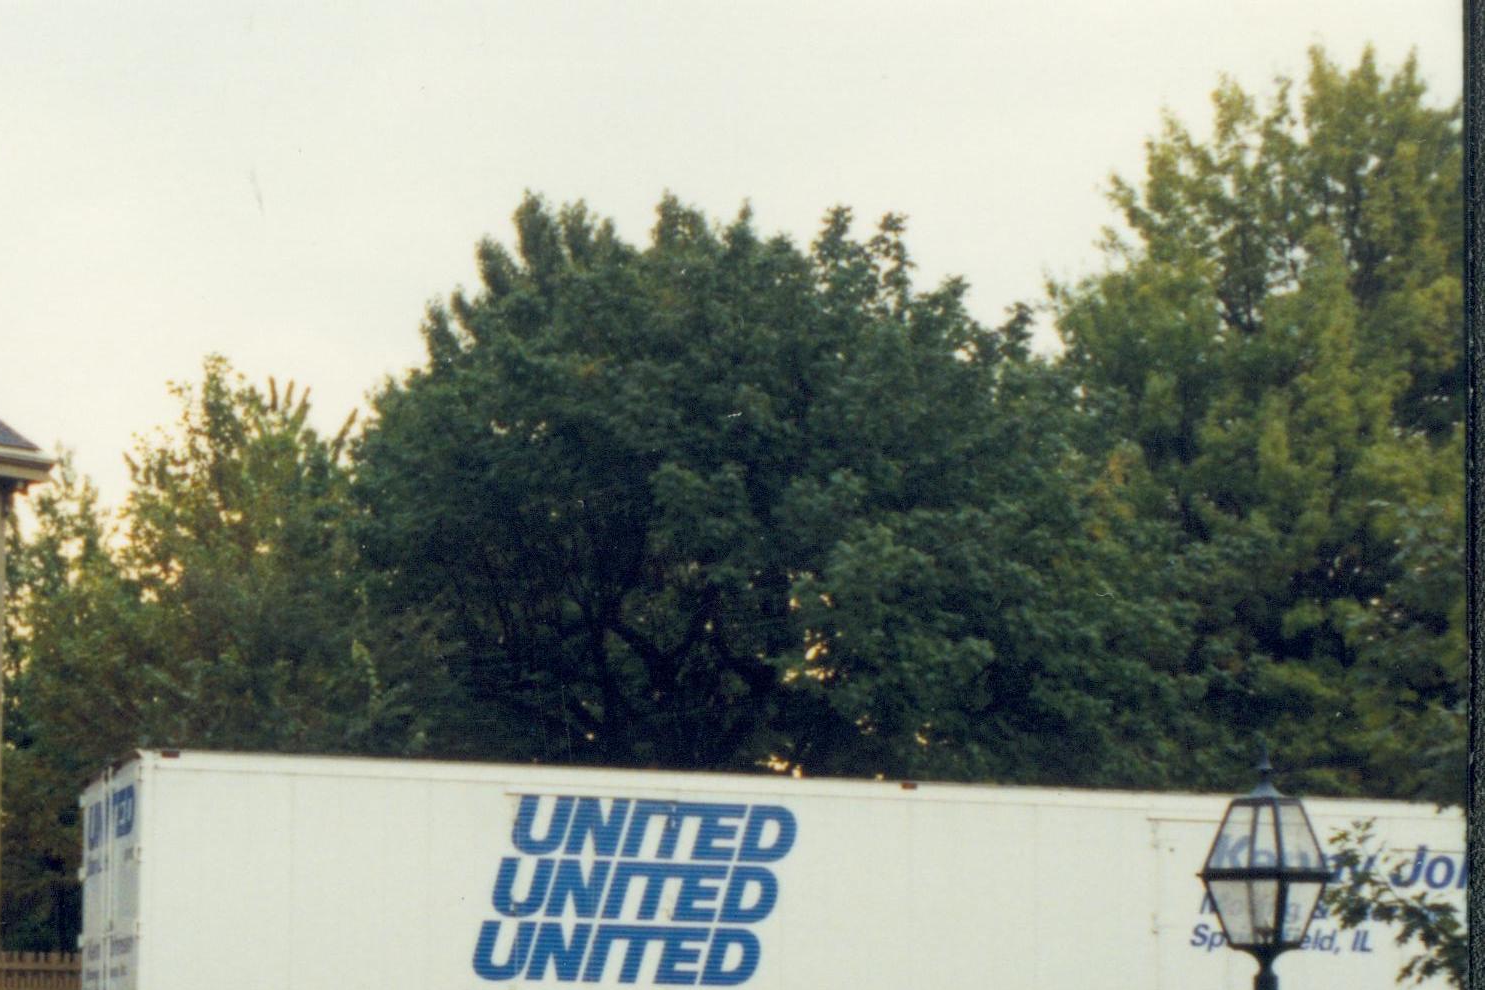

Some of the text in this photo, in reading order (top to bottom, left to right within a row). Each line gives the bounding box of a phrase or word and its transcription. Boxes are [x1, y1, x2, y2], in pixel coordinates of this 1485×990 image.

[511, 794, 798, 863] UNITED
[491, 857, 779, 923] UNITED
[472, 920, 761, 986] UNITED
[1190, 923, 1373, 953] Speld, IL
